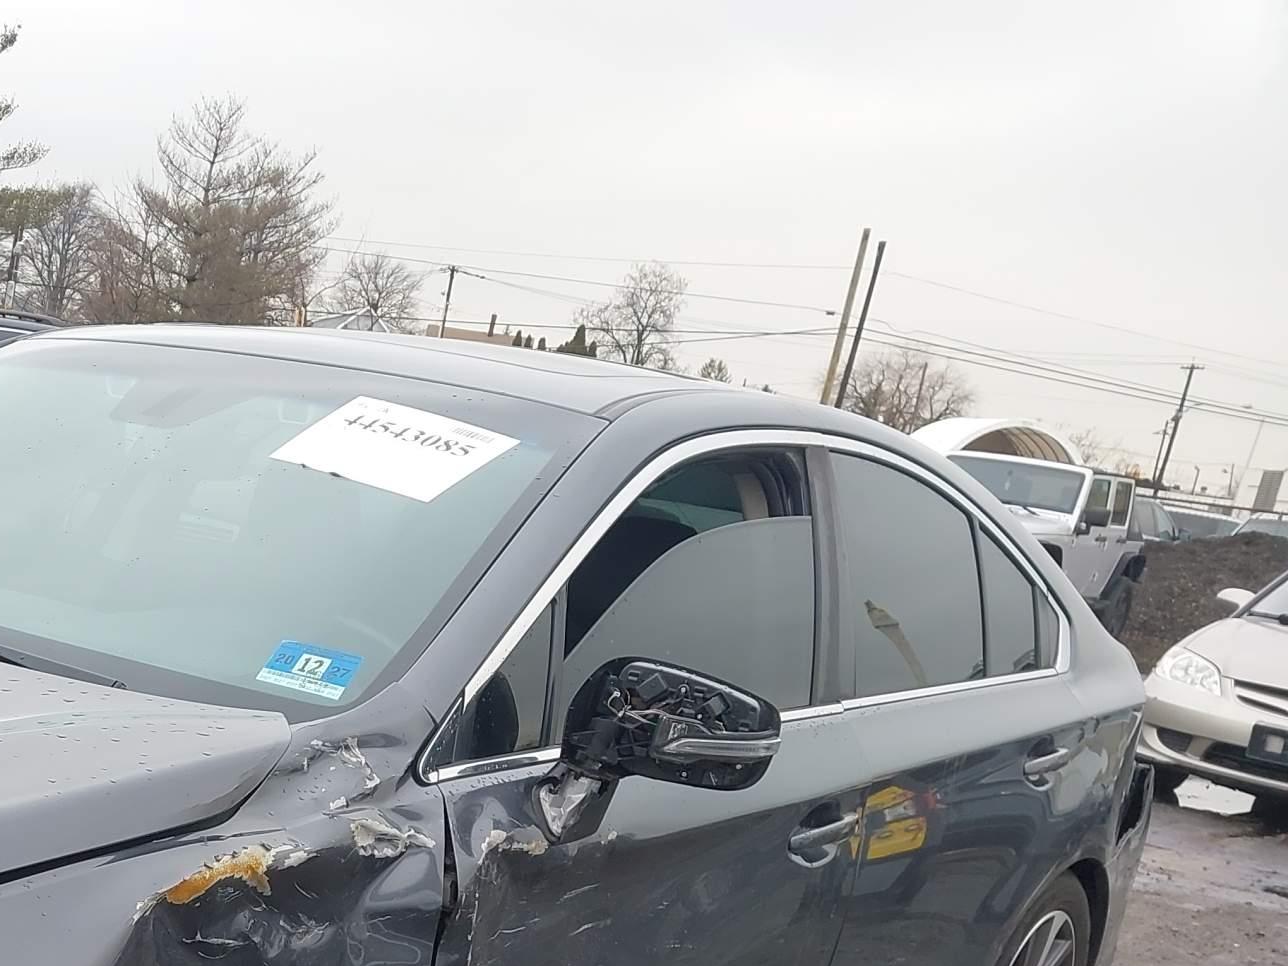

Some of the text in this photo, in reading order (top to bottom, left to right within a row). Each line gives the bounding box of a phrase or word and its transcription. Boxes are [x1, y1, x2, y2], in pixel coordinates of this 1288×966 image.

[344, 415, 477, 456] 44543085
[276, 653, 352, 679] 20 12 27
